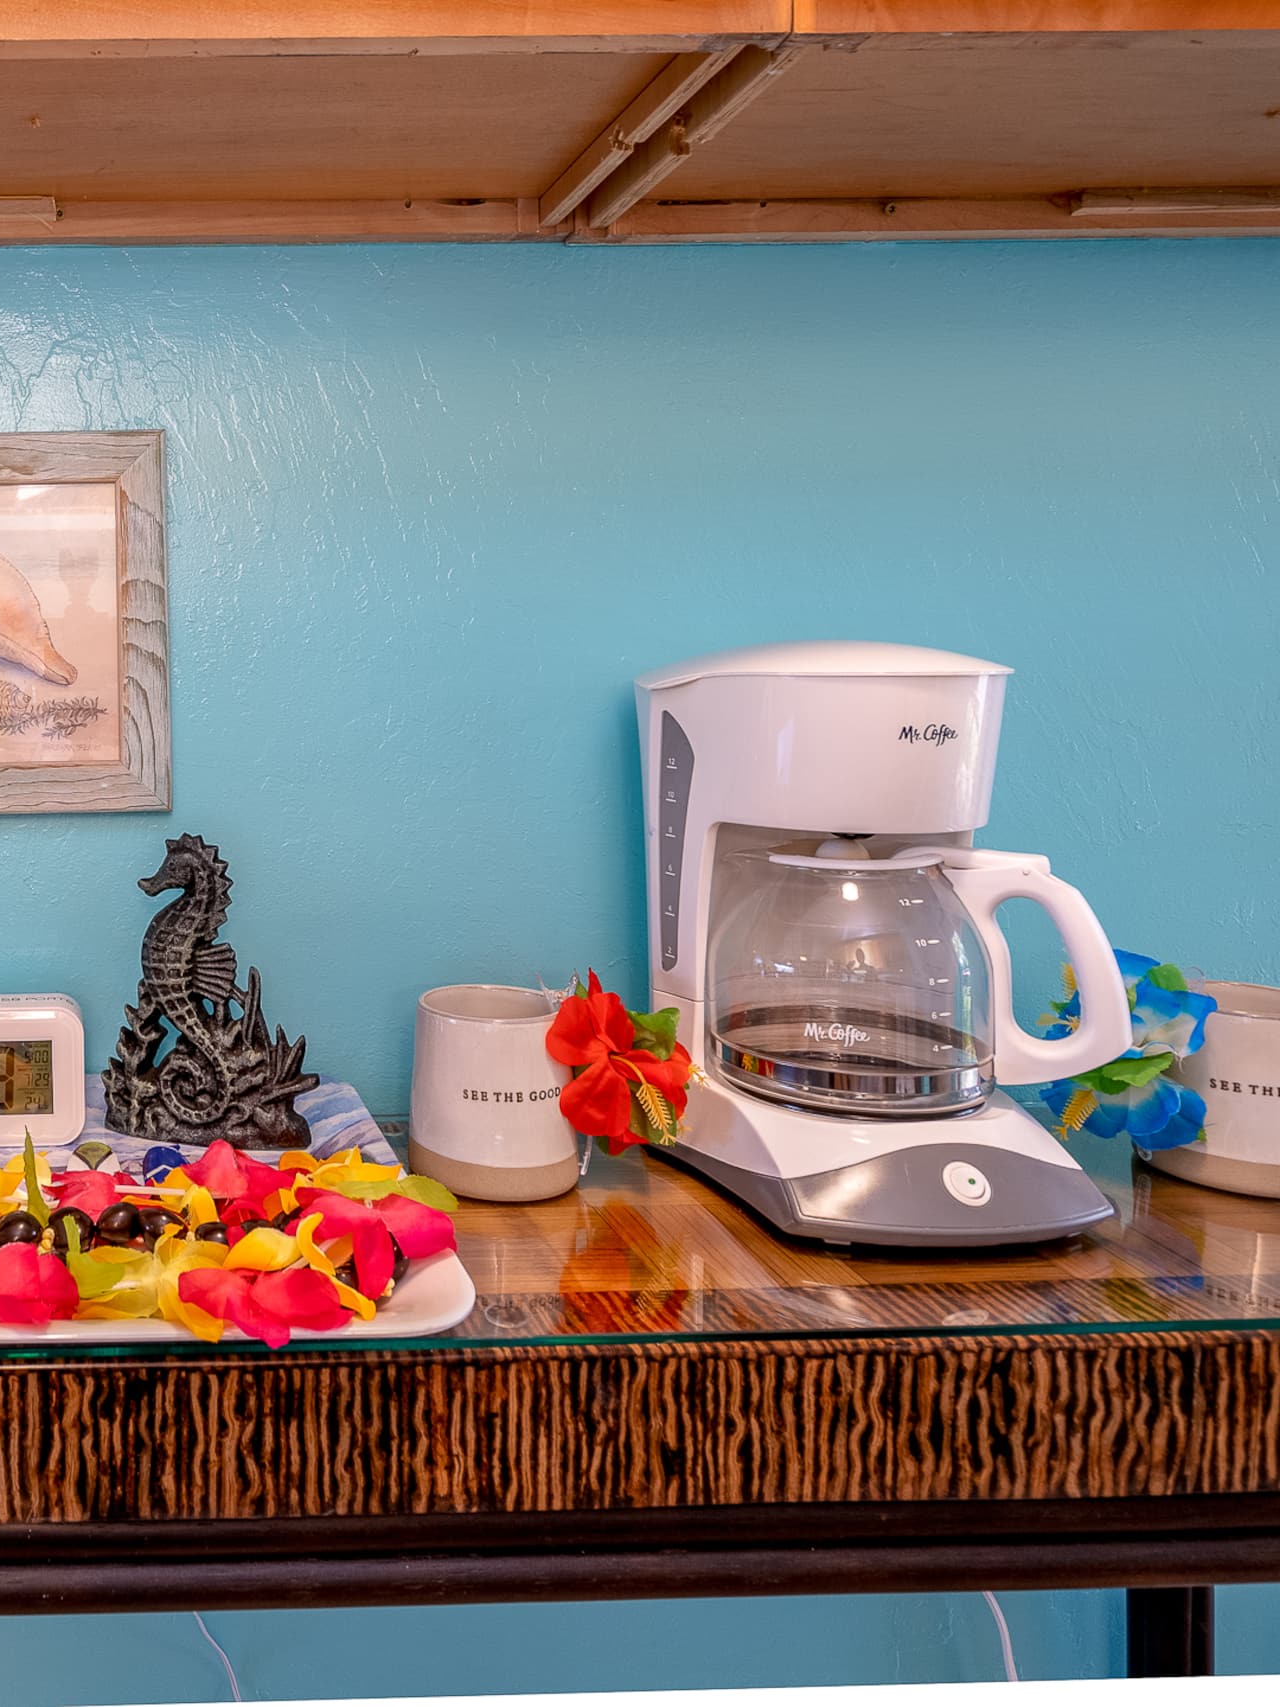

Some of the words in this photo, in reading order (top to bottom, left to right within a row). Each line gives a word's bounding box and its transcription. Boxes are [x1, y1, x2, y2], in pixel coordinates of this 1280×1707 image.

[898, 725, 922, 744] Mr.
[923, 723, 959, 747] Coffee
[668, 758, 676, 766] 12
[667, 791, 675, 799] 10
[899, 898, 911, 907] 12
[915, 938, 927, 948] 10
[928, 977, 936, 986] 8
[931, 1011, 938, 1020] 6
[803, 1022, 828, 1042] Mr.
[828, 1022, 871, 1047] Coffee
[932, 1044, 940, 1053] 4
[34, 1072, 50, 1087] 29
[1209, 1077, 1243, 1094] SEE
[462, 1088, 489, 1102] SEE
[493, 1091, 524, 1103] THE
[529, 1086, 561, 1102] GOOD
